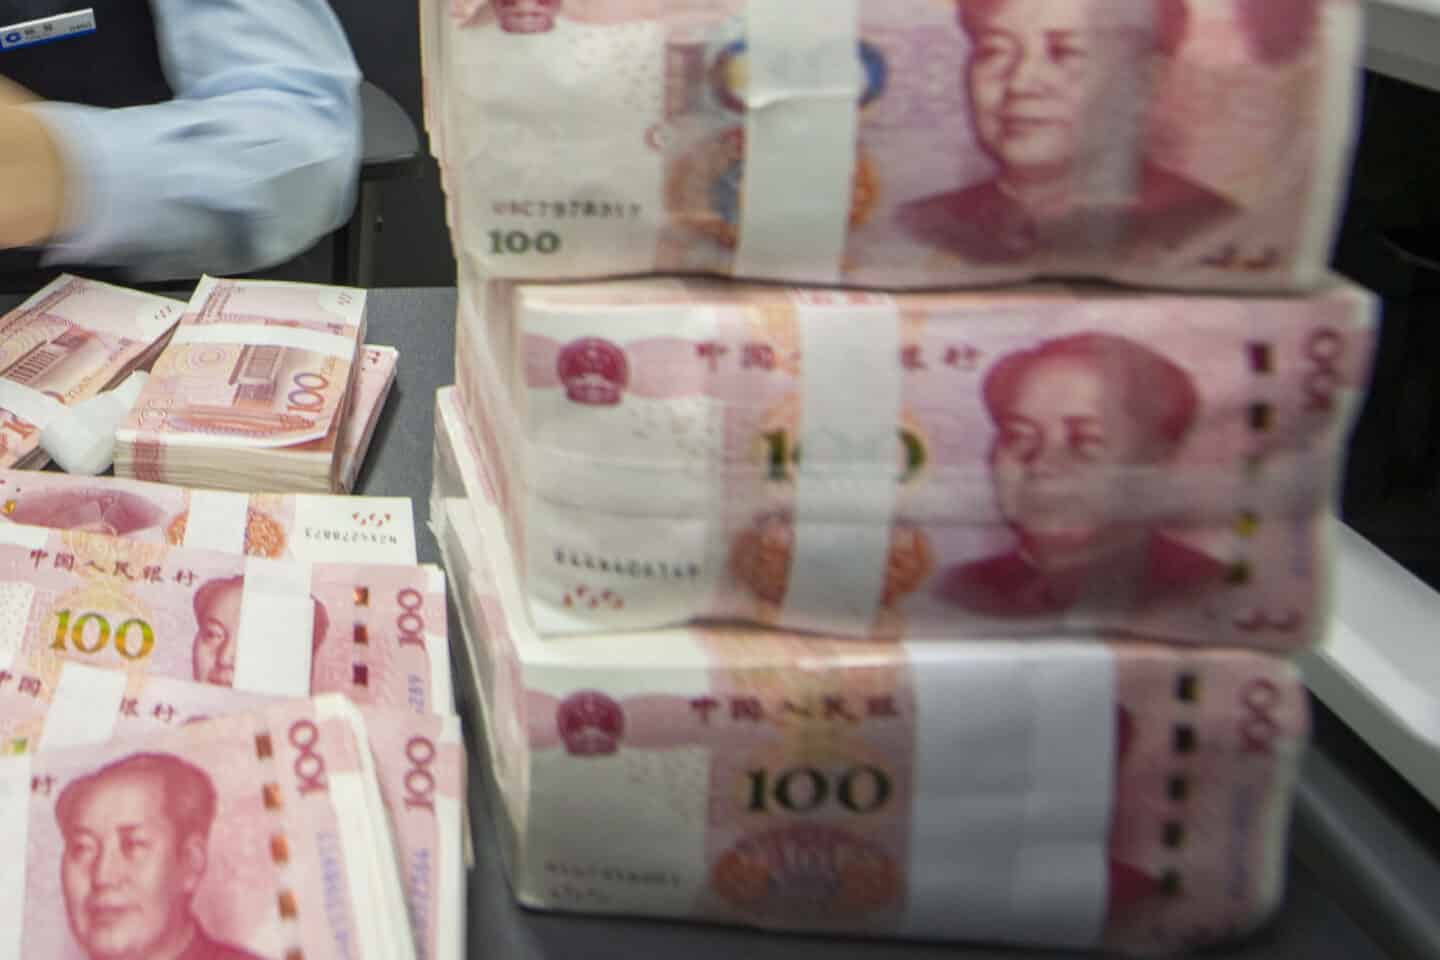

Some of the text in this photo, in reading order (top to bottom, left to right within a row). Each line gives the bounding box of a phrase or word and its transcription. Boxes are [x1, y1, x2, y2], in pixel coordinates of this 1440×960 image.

[488, 228, 561, 256] 100
[287, 372, 329, 414] 100
[29, 548, 200, 586] 中国人民银行
[49, 607, 156, 662] 100
[397, 588, 426, 649] 100
[288, 720, 329, 796] 100
[403, 736, 436, 813] 100
[744, 764, 893, 815] 100
